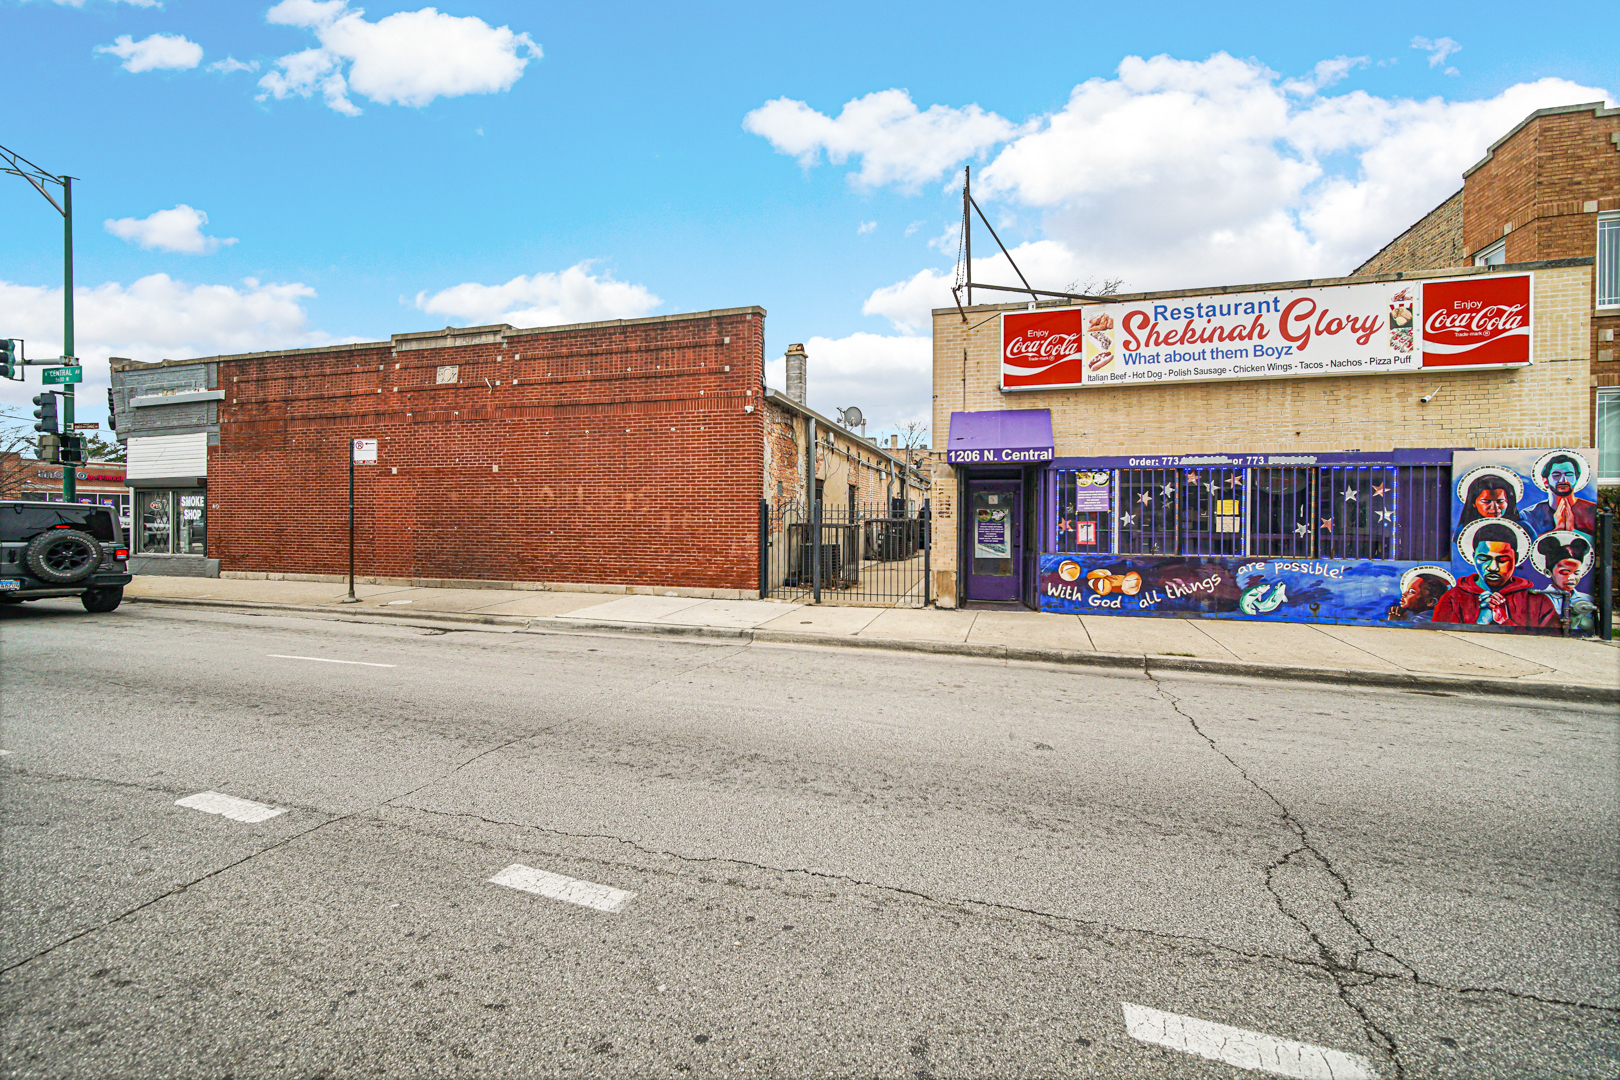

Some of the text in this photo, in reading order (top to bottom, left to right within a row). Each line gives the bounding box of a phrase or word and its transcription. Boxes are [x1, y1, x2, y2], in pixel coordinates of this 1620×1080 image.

[1153, 296, 1280, 322] Restaurant
[1454, 300, 1483, 310] Enjoy
[1122, 297, 1385, 352] Shekinah Glory
[1425, 302, 1528, 334] Coca-Cola
[1027, 329, 1049, 338] Enjoy
[1006, 333, 1081, 358] Coca-Cola
[1123, 344, 1293, 366] What about them Boyz
[49, 369, 73, 377] CENTRAL
[1087, 355, 1412, 382] Italian Beef Hot Dog Polish Sausage Chicken Wings Tacos Nachos Pizza Puff
[949, 448, 1053, 462] 1206 N. Central
[1129, 457, 1159, 466] Order:
[1232, 457, 1243, 465] or
[1246, 456, 1265, 465] 773
[87, 474, 96, 482] by
[97, 474, 125, 482] T-Mobil
[181, 495, 205, 507] SMOKE
[183, 508, 202, 520] SHOP
[1046, 560, 1345, 609] With God all things are possible!
